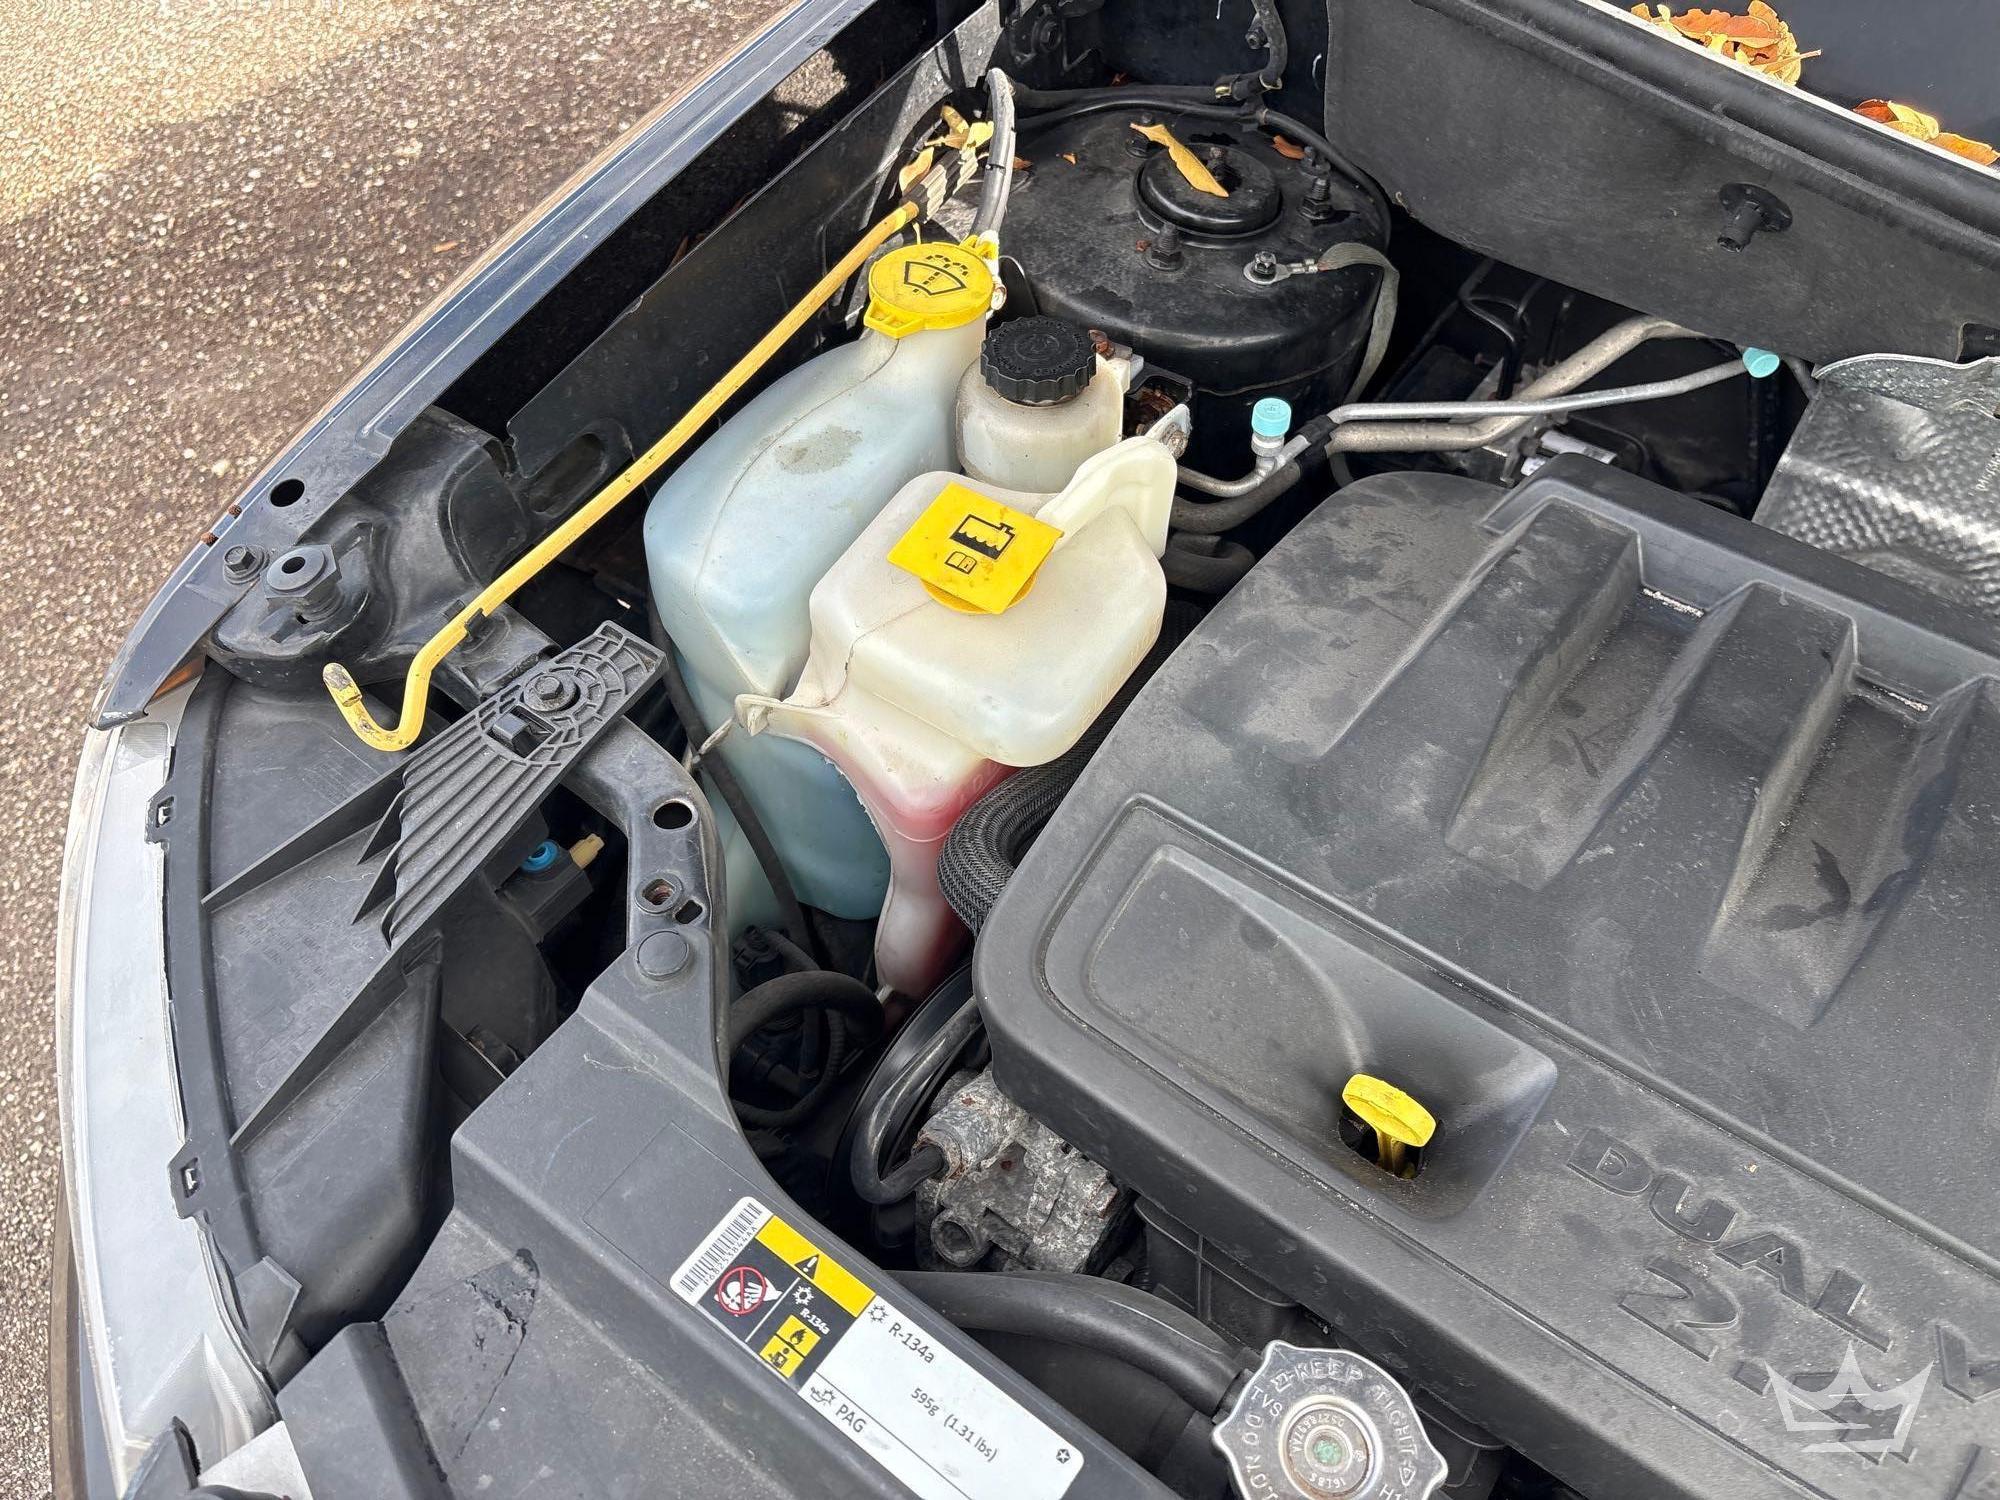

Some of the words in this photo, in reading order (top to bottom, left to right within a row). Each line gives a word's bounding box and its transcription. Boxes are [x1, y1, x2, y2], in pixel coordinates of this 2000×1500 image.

[1566, 1127, 1895, 1353] DUAL
[799, 1308, 831, 1335] R-134a
[888, 1322, 935, 1364] R-134a
[835, 1404, 867, 1434] PAG
[1251, 1385, 1283, 1417] TVS
[910, 1387, 940, 1417] 595g
[943, 1413, 975, 1444] (1.31
[973, 1436, 999, 1463] lbs)
